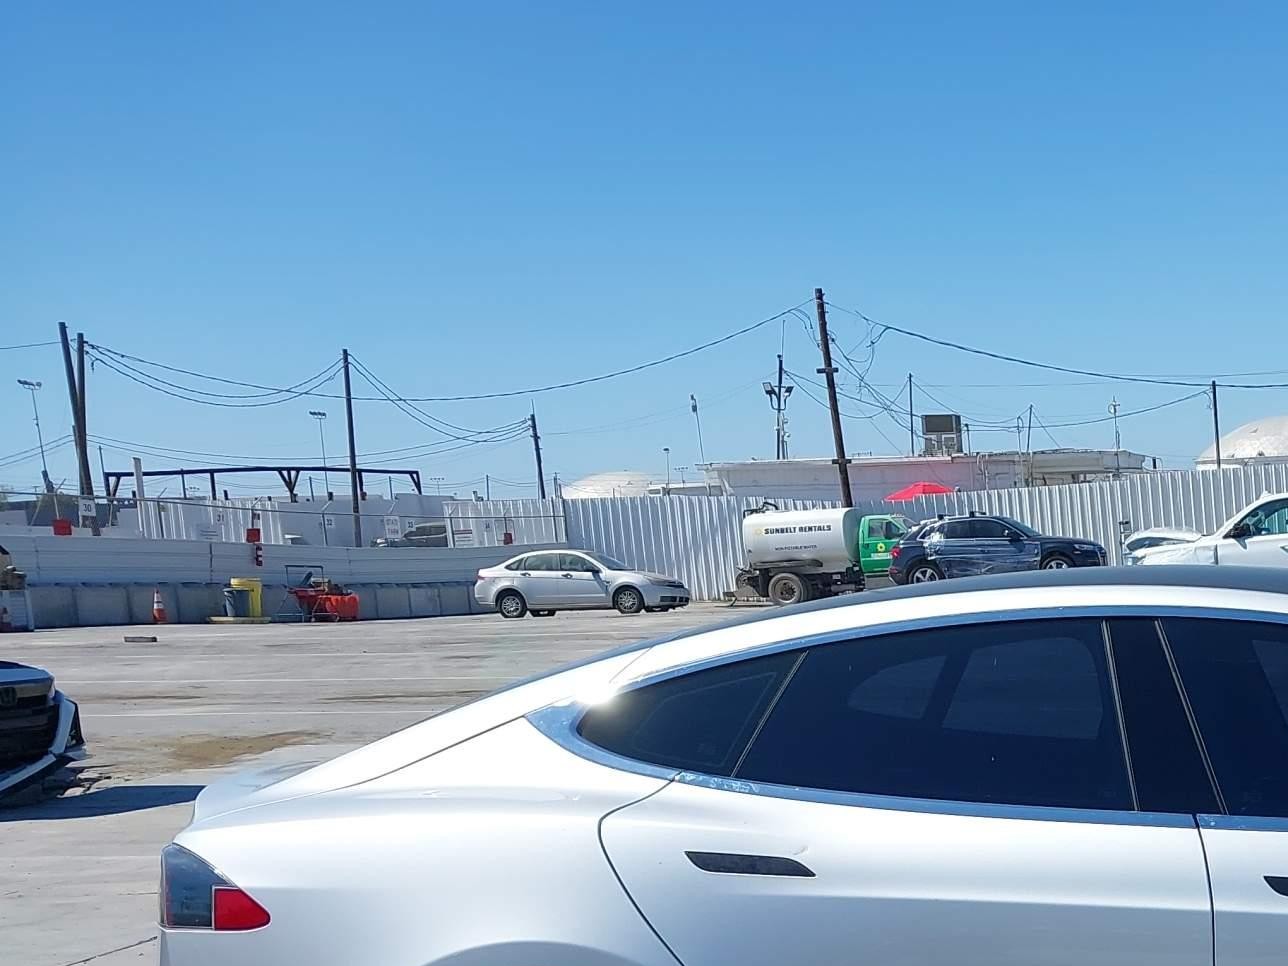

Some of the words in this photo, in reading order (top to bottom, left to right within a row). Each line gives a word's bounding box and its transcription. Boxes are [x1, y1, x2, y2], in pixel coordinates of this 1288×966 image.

[83, 503, 92, 512] 30
[764, 526, 797, 535] SUNBELT
[798, 524, 831, 533] RENTALS
